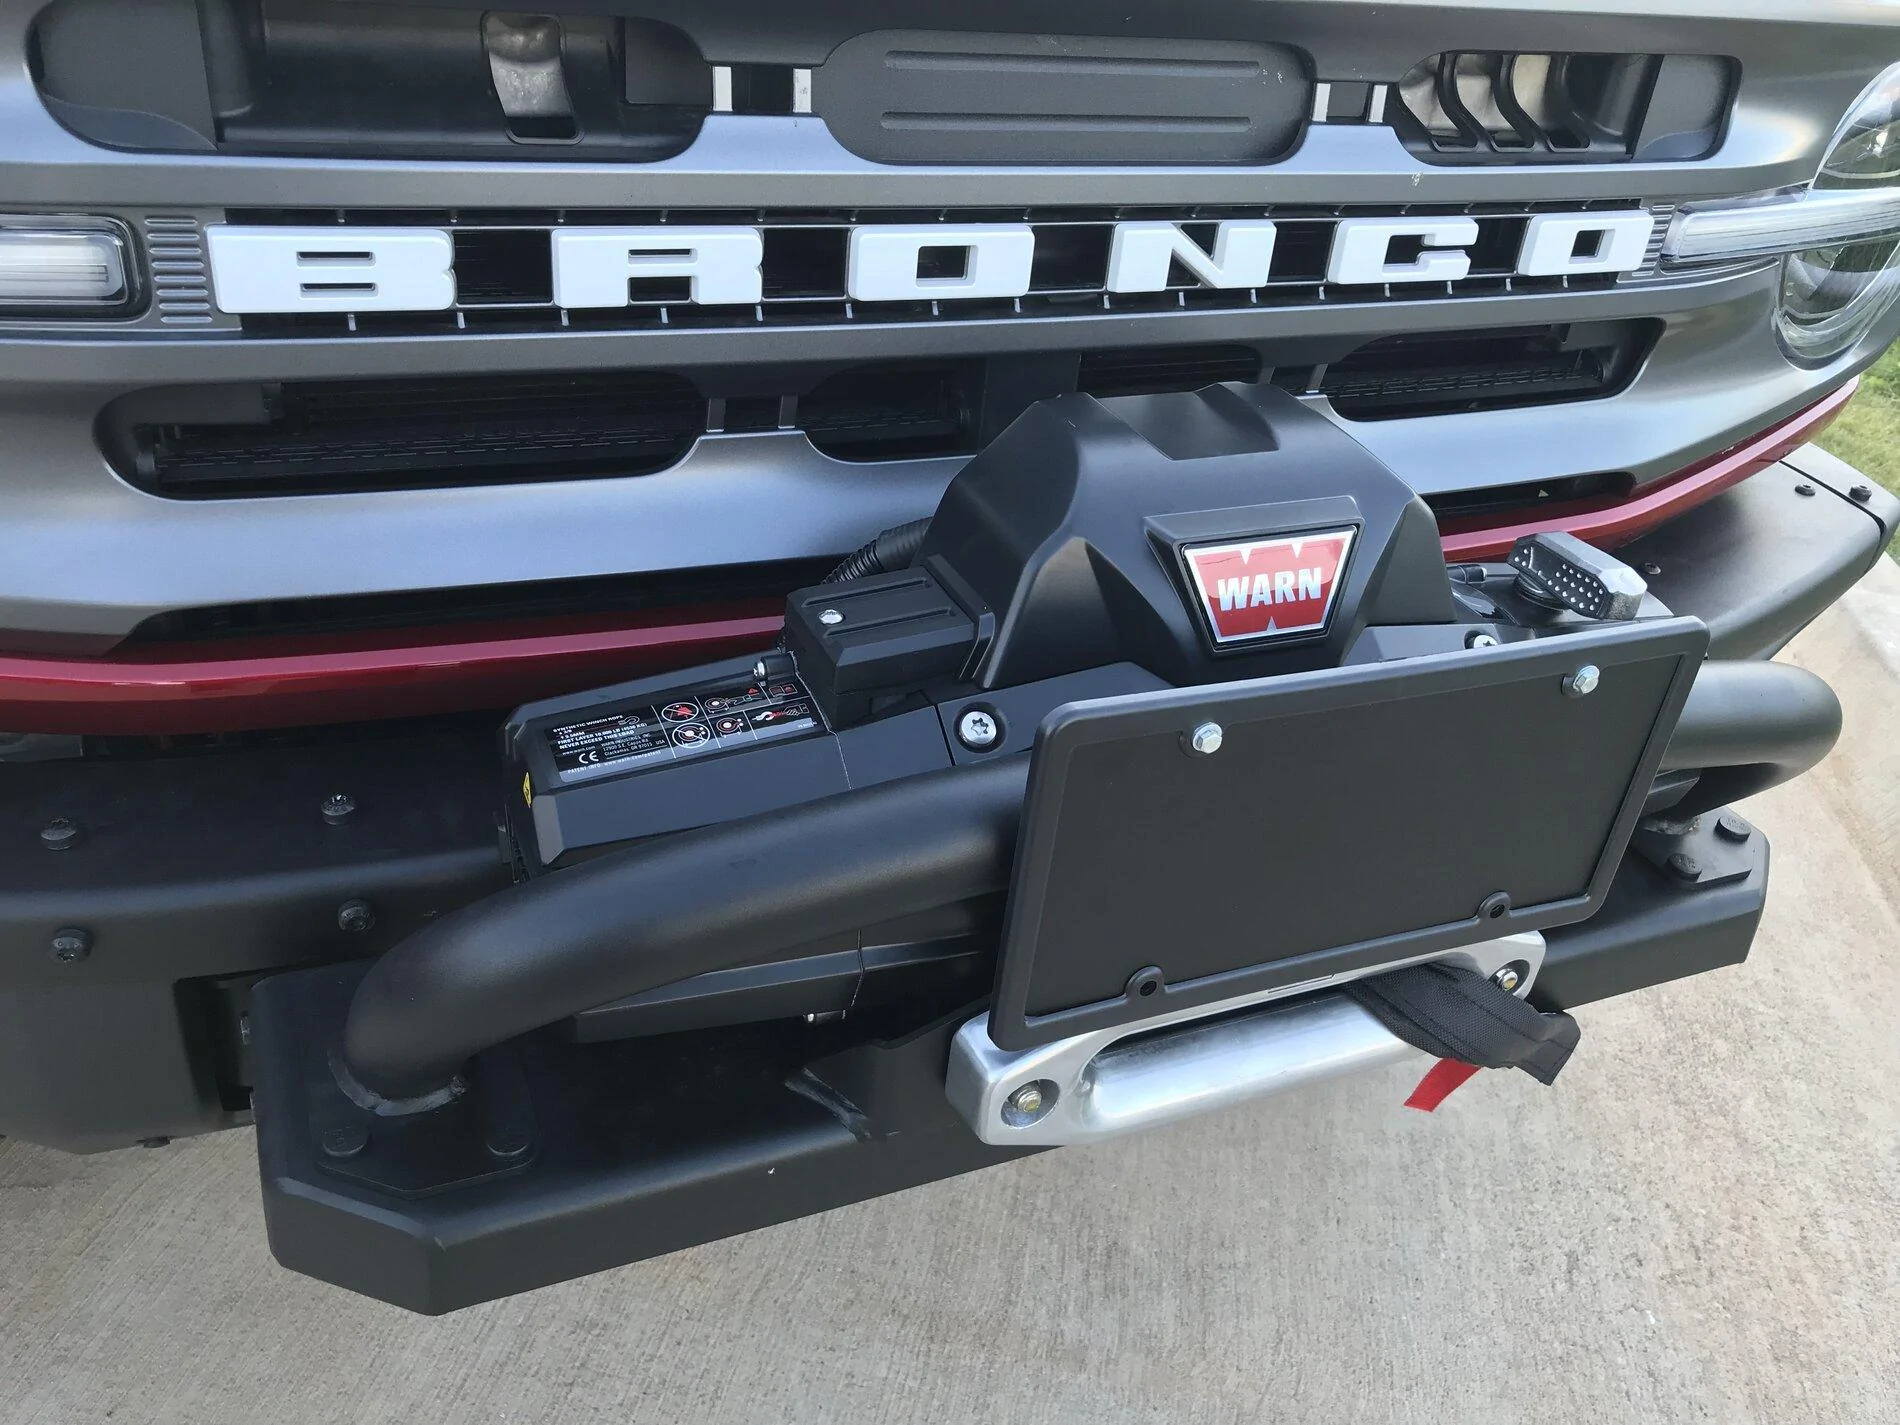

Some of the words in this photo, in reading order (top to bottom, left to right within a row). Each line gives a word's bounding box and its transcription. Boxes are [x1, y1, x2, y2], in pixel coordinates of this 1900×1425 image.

[206, 209, 1655, 314] BRONCO
[1217, 567, 1322, 611] WARN
[553, 723, 586, 733] SYNTHETIC
[586, 718, 608, 726] WINCH
[558, 737, 575, 745] FIRST
[575, 733, 594, 742] LAYER
[559, 741, 580, 749] NEVER
[580, 737, 603, 745] EXCEED
[618, 729, 635, 737] LOAD
[578, 750, 599, 764] CE
[567, 765, 587, 774] PATENT
